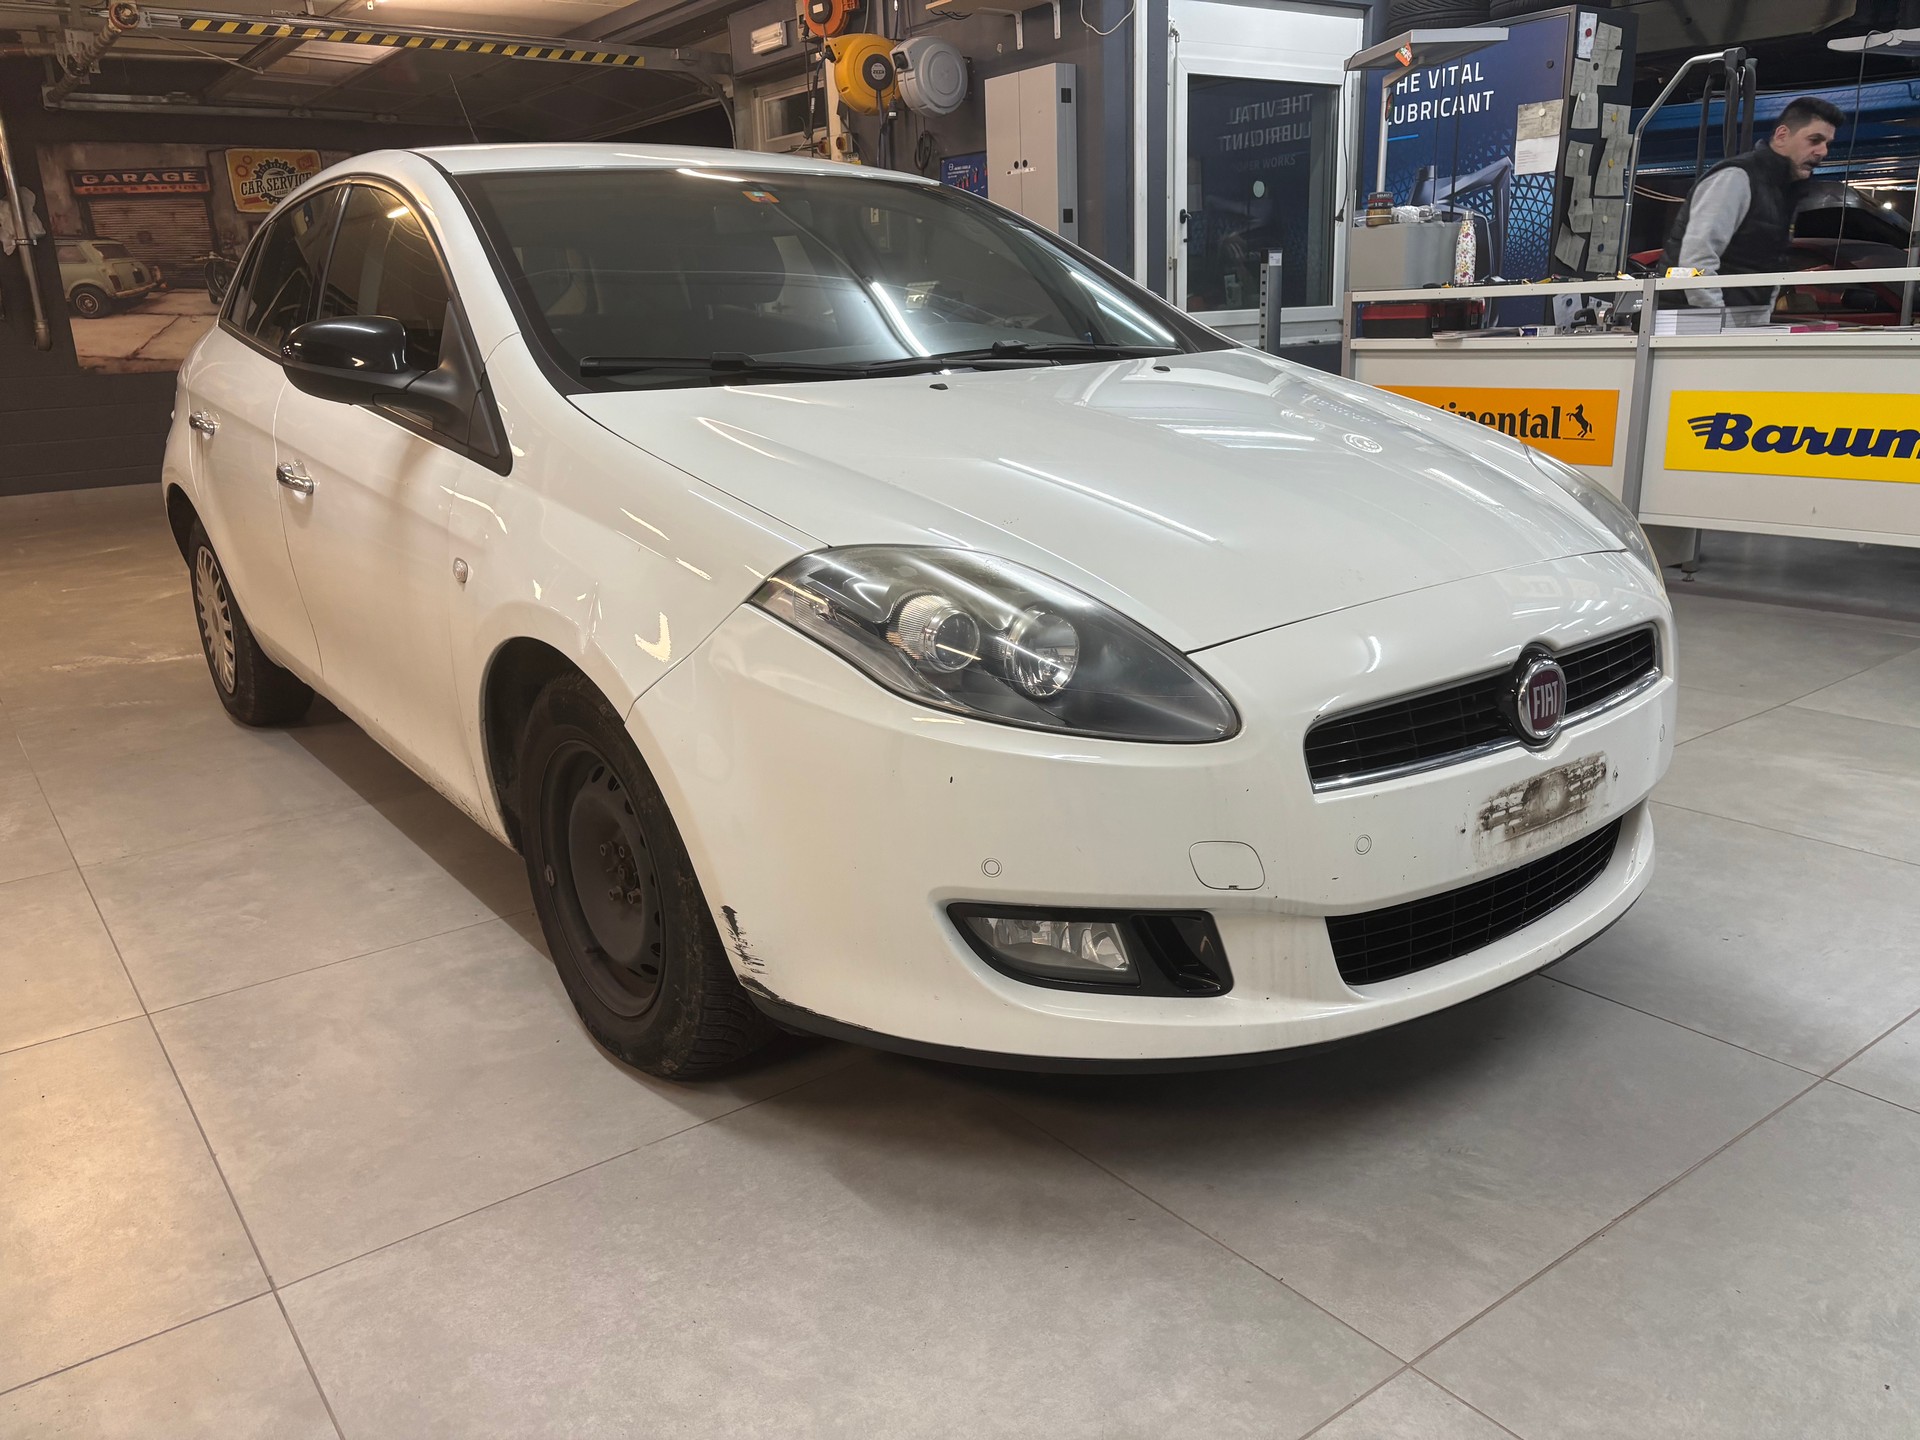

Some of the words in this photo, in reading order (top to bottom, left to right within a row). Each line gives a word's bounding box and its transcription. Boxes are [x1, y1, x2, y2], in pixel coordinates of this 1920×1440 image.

[1396, 73, 1420, 95] HE
[1428, 61, 1484, 90] VITAL
[1388, 90, 1495, 125] UBRICANT
[81, 172, 199, 184] GARAGE
[241, 180, 265, 196] CAR
[266, 172, 312, 192] SERVICE
[1533, 680, 1559, 720] FIAT
